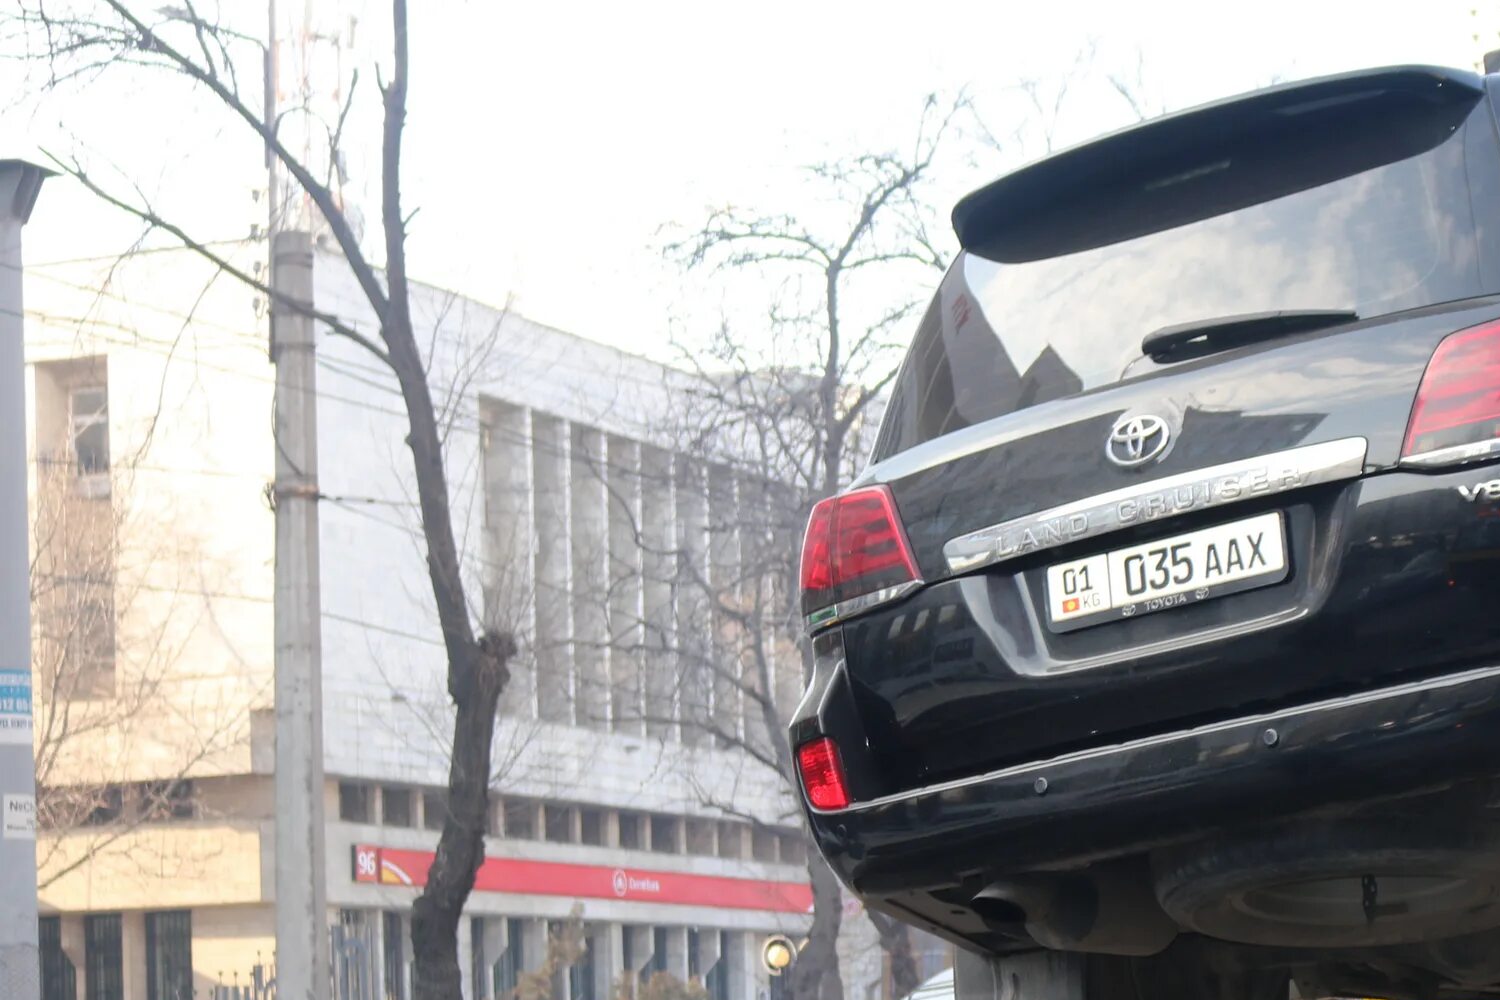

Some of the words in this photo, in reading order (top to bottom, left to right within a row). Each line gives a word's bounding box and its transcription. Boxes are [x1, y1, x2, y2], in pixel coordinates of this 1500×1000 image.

[996, 513, 1090, 556] LAND
[1116, 468, 1303, 524] CRUISER
[1124, 542, 1194, 596] 035
[1205, 532, 1267, 578] AAX
[1063, 565, 1093, 595] 01
[1082, 592, 1101, 609] KG
[1143, 593, 1188, 611] TOYOTA
[357, 851, 376, 876] 96
